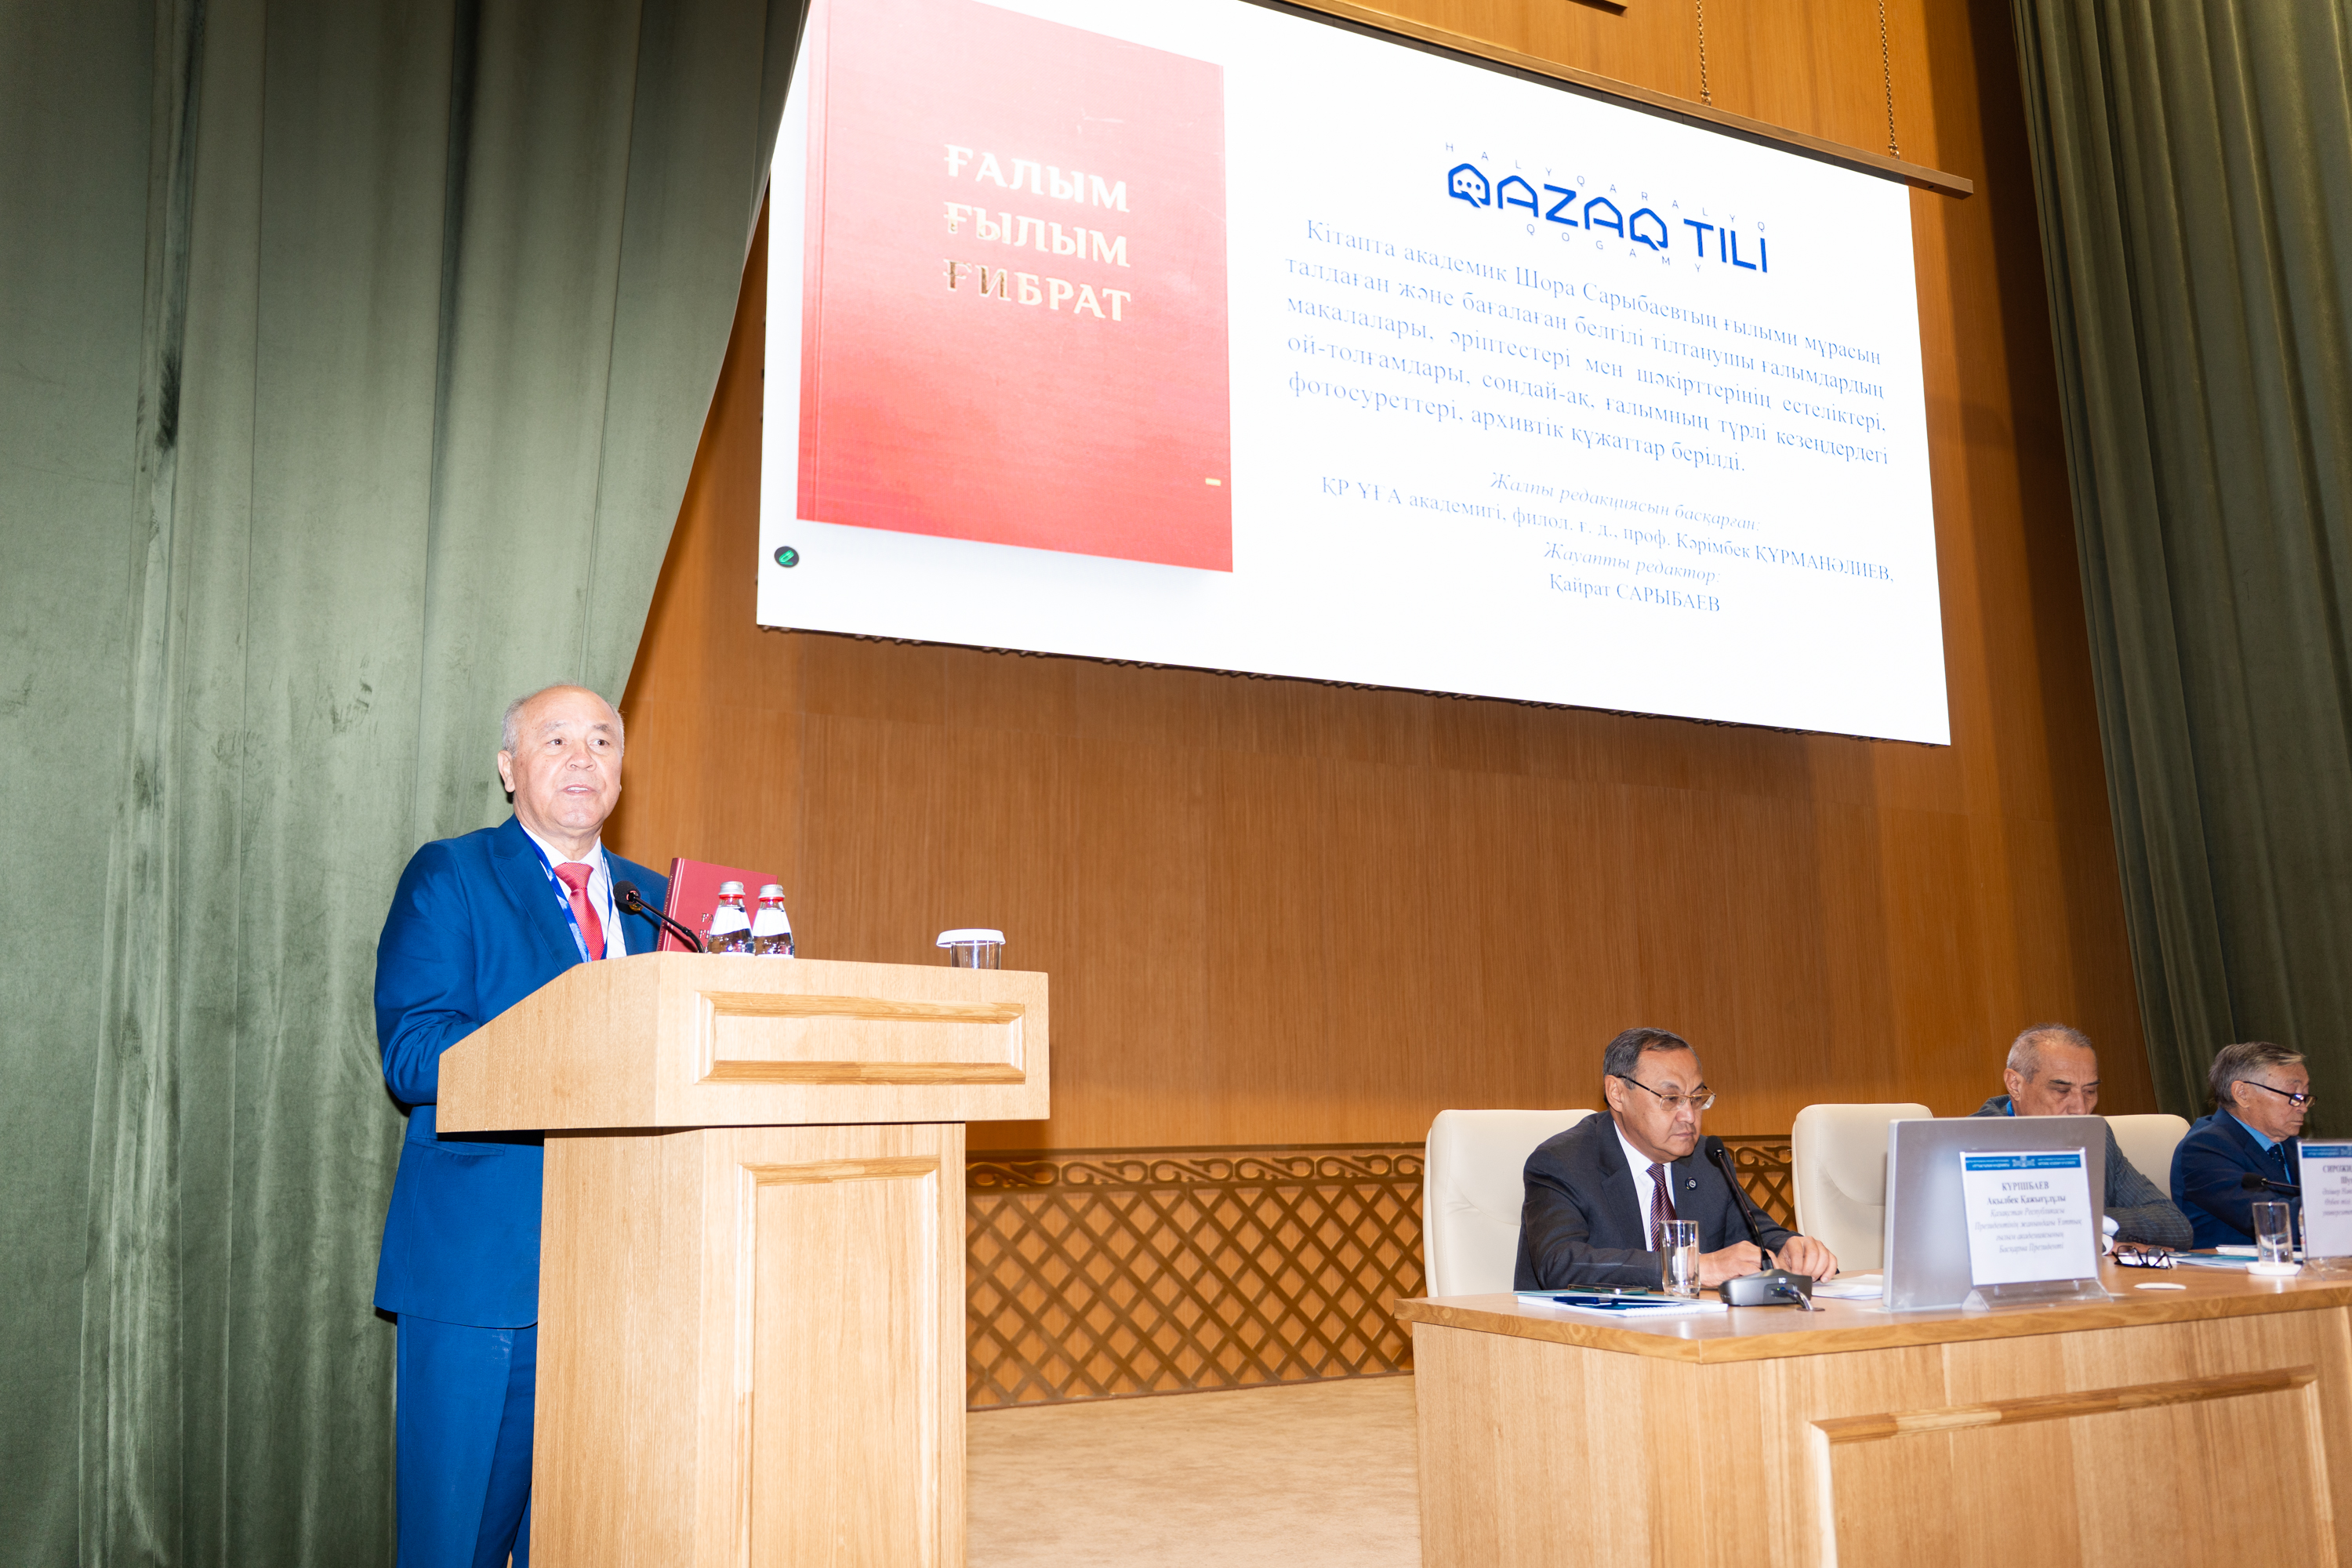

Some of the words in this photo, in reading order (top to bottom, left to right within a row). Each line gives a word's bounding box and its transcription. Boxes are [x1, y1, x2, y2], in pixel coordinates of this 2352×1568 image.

[943, 143, 1131, 213] ҒАЛЫМ
[943, 201, 1131, 267] ҒЫЛЫМ
[1447, 162, 1669, 252] QAZAQ
[1683, 218, 1768, 274] TILI
[942, 259, 1131, 322] ҒИБРАТ
[1307, 219, 1396, 257] Кітапта
[1404, 247, 1507, 282] академик
[1515, 266, 1575, 299] Шора
[1582, 282, 1718, 330] Сарыбаевтың
[1723, 318, 1798, 347] ғылыми
[1285, 258, 1389, 293] талдаған
[1398, 282, 1454, 307] және
[1462, 292, 1566, 331] бағалаған
[1574, 315, 1644, 347] белгілі
[1650, 333, 1755, 371] тілтанушы
[1762, 360, 1885, 400] ғалымдардың
[1287, 334, 1471, 386] ой-толғамдары,
[1482, 375, 1595, 409] сондай-ақ,
[1606, 397, 1710, 432] ғалымның
[1718, 419, 1766, 442] түрлі
[1450, 329, 1570, 371] әріптестері
[1585, 358, 1623, 378] мен
[1637, 368, 1772, 410] шәкірттерінің
[1782, 399, 1886, 434] естеліктері,
[1289, 371, 1464, 423] фотосуреттері,
[1472, 409, 1564, 439] архивтік
[1671, 441, 1745, 472] берілді.
[1409, 495, 1507, 521] академигі,
[1512, 506, 1573, 531] филол.
[1624, 528, 1671, 550] проф.
[1676, 532, 1751, 559] Кәрімбек
[1490, 472, 1554, 497] Жалпы
[1559, 488, 1669, 516] редакциясын
[1543, 541, 1630, 569] Жауапты
[1635, 560, 1721, 586] редактор:
[1550, 573, 1611, 599] Қайрат
[1616, 583, 1720, 612] САРЫБАЕВ
